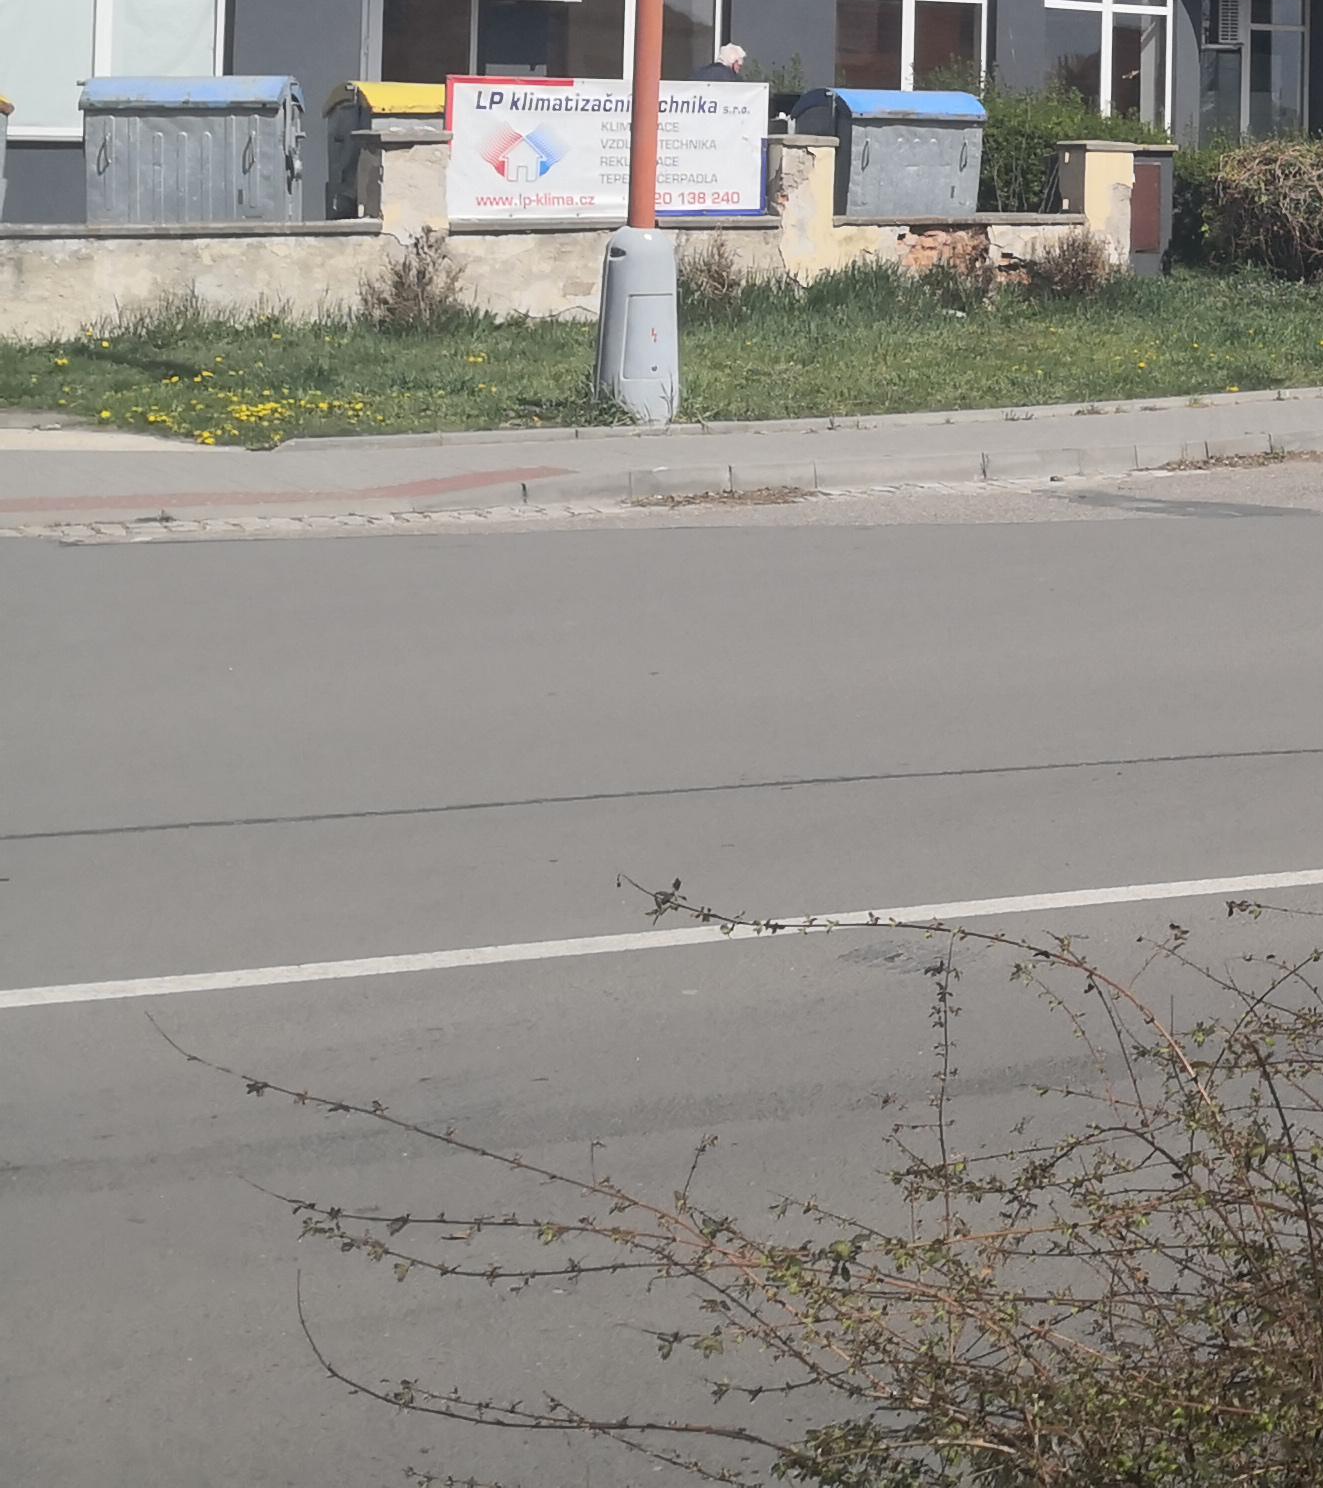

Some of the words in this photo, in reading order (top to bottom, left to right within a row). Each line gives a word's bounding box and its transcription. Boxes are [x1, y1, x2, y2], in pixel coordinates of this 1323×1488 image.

[475, 90, 504, 110] LP
[658, 95, 718, 114] chnika
[475, 193, 596, 208] www.lp-klima.cz
[679, 192, 706, 204] 138
[711, 192, 741, 204] 240
